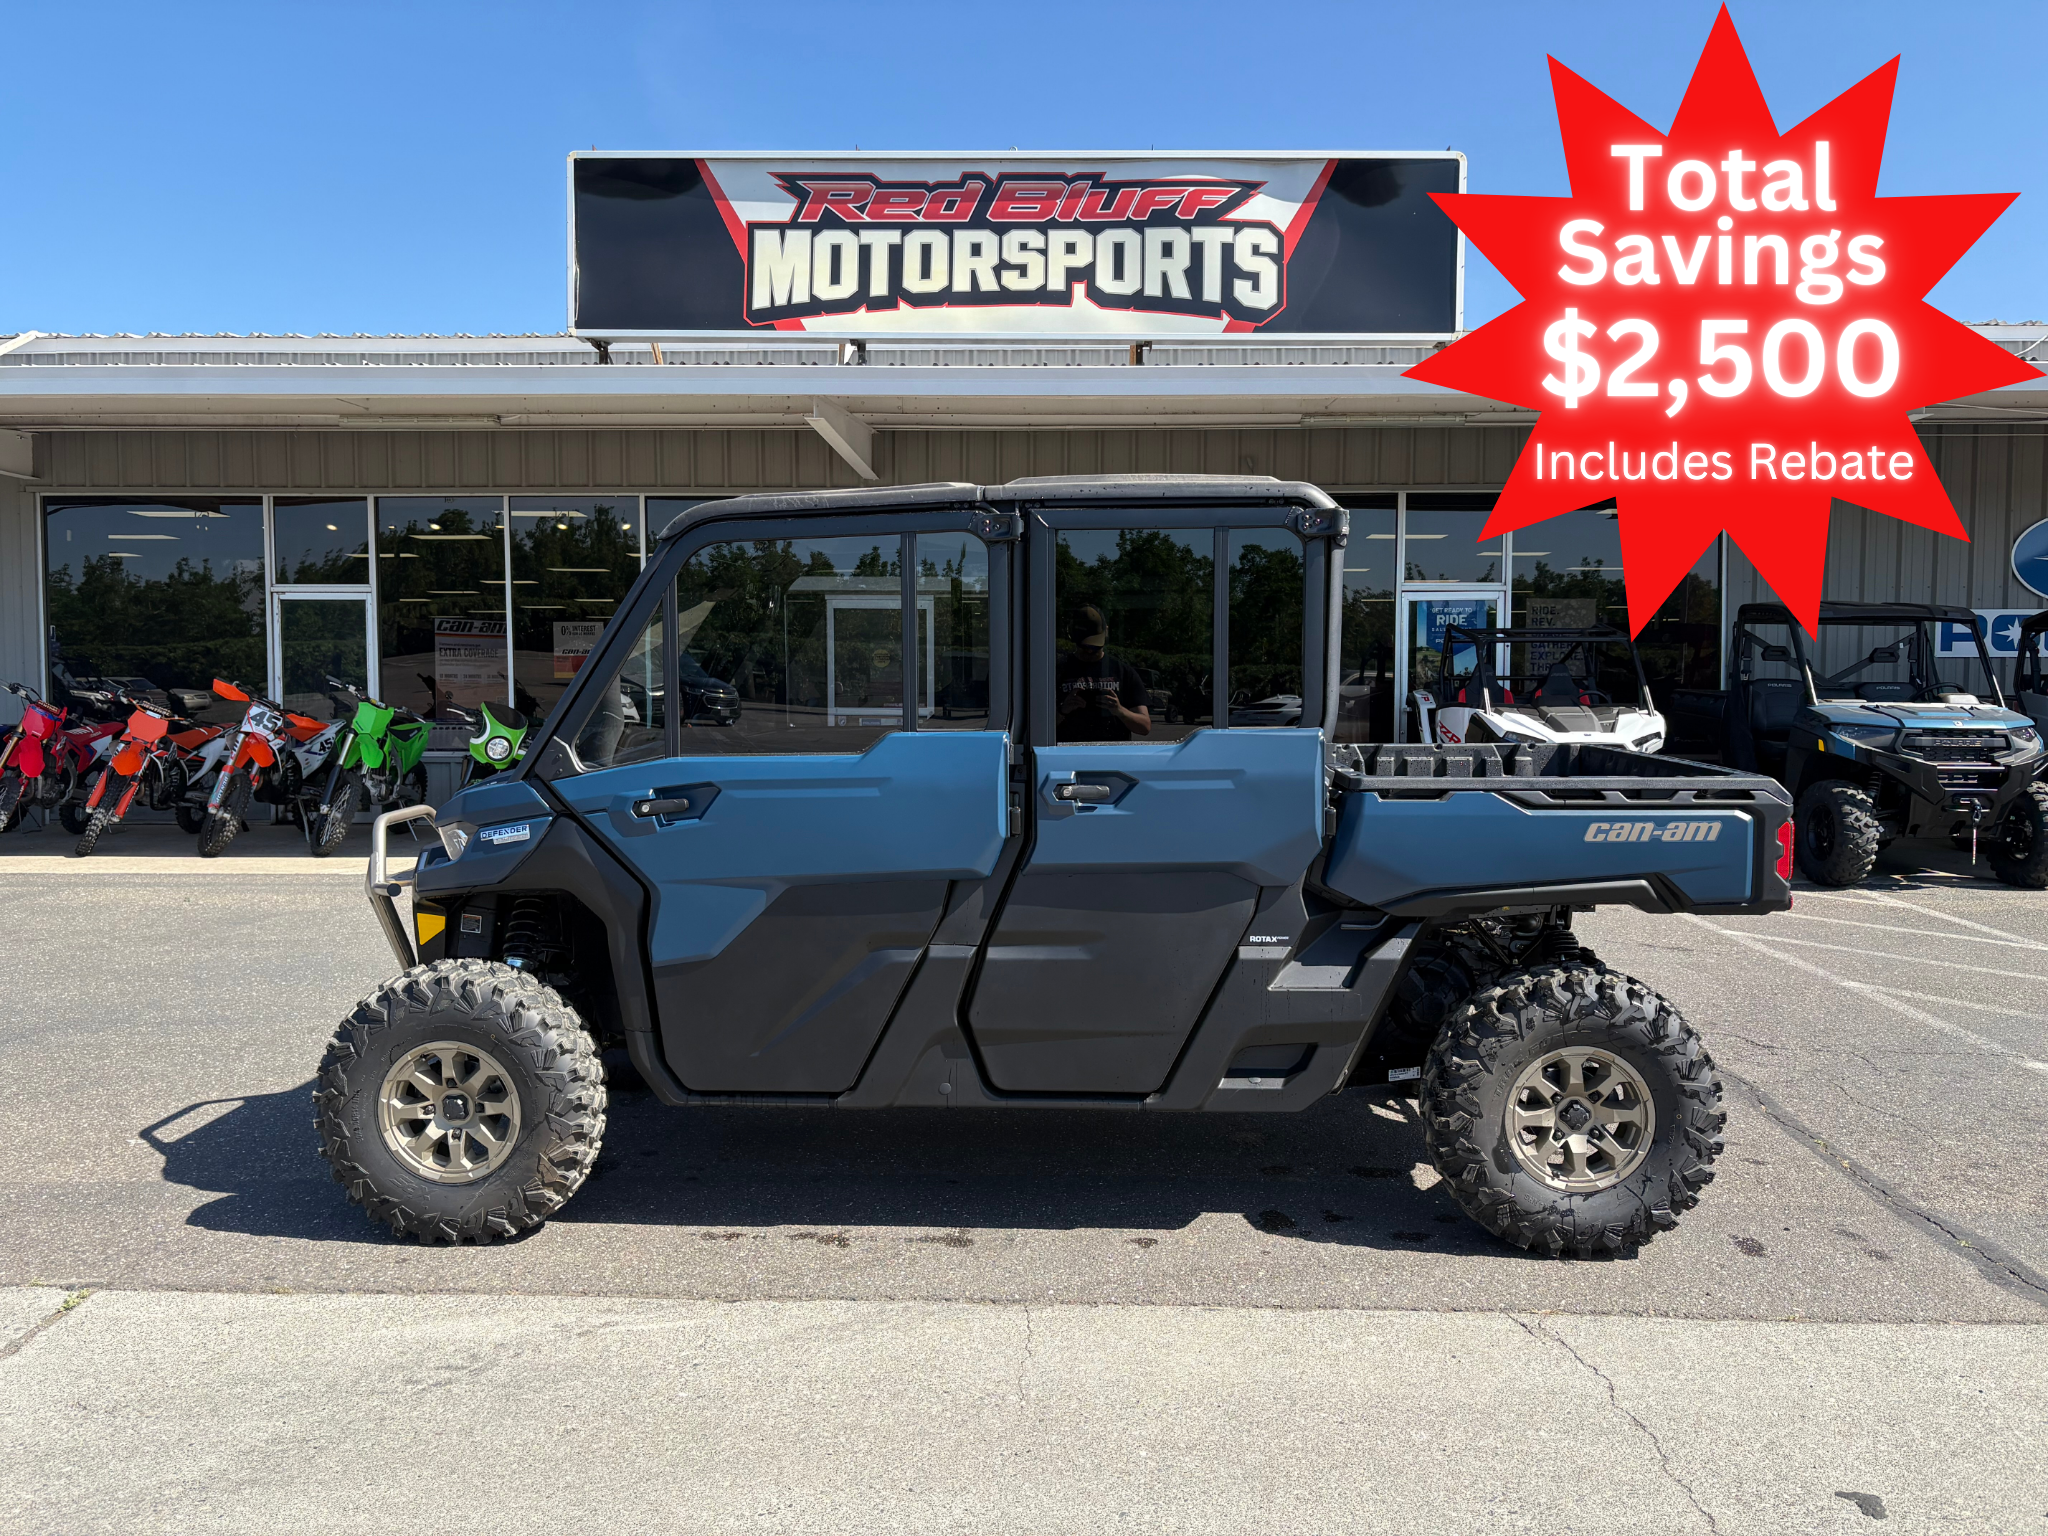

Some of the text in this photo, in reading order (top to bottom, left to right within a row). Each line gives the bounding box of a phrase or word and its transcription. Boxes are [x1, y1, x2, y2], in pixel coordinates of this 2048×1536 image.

[796, 180, 1242, 222] Red Bluff
[752, 226, 1279, 311] MOTORSPORTS
[1531, 606, 1560, 615] RIDE.
[436, 619, 507, 635] can-am
[1436, 614, 1468, 627] RIDE
[1531, 617, 1556, 627] REV.
[439, 647, 499, 658] EXTRA COVERAGE
[1530, 651, 1584, 661] EXPLOE.
[249, 711, 283, 732] 45
[318, 736, 335, 753] 45
[481, 825, 528, 839] DEFENDER
[1583, 820, 1723, 843] can-am
[1249, 935, 1278, 943] ROTAX
